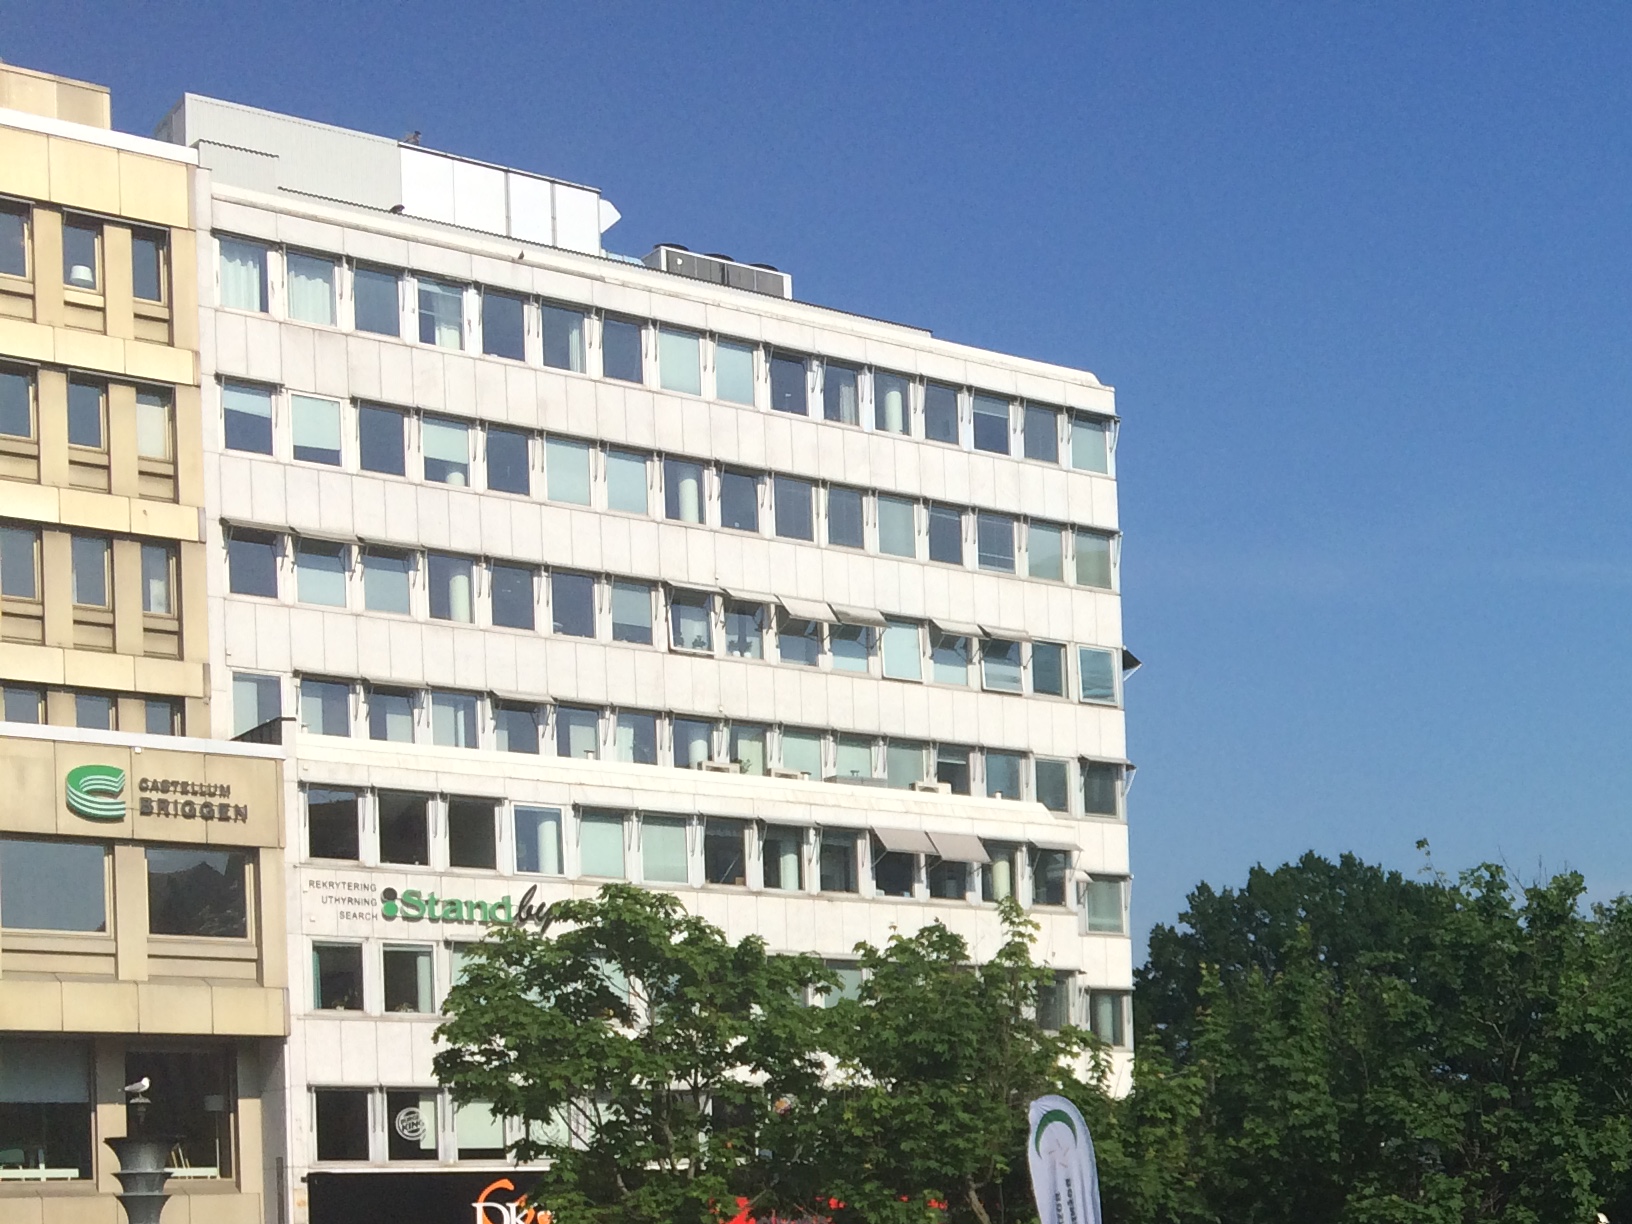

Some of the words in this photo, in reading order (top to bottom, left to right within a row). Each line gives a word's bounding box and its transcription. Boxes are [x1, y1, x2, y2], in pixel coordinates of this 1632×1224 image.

[139, 777, 231, 799] CASTELLUM
[139, 797, 248, 823] BRIGGEN
[308, 879, 377, 892] REKRYTERING
[321, 895, 378, 907] UTHYRNING
[339, 910, 379, 921] SEARCH
